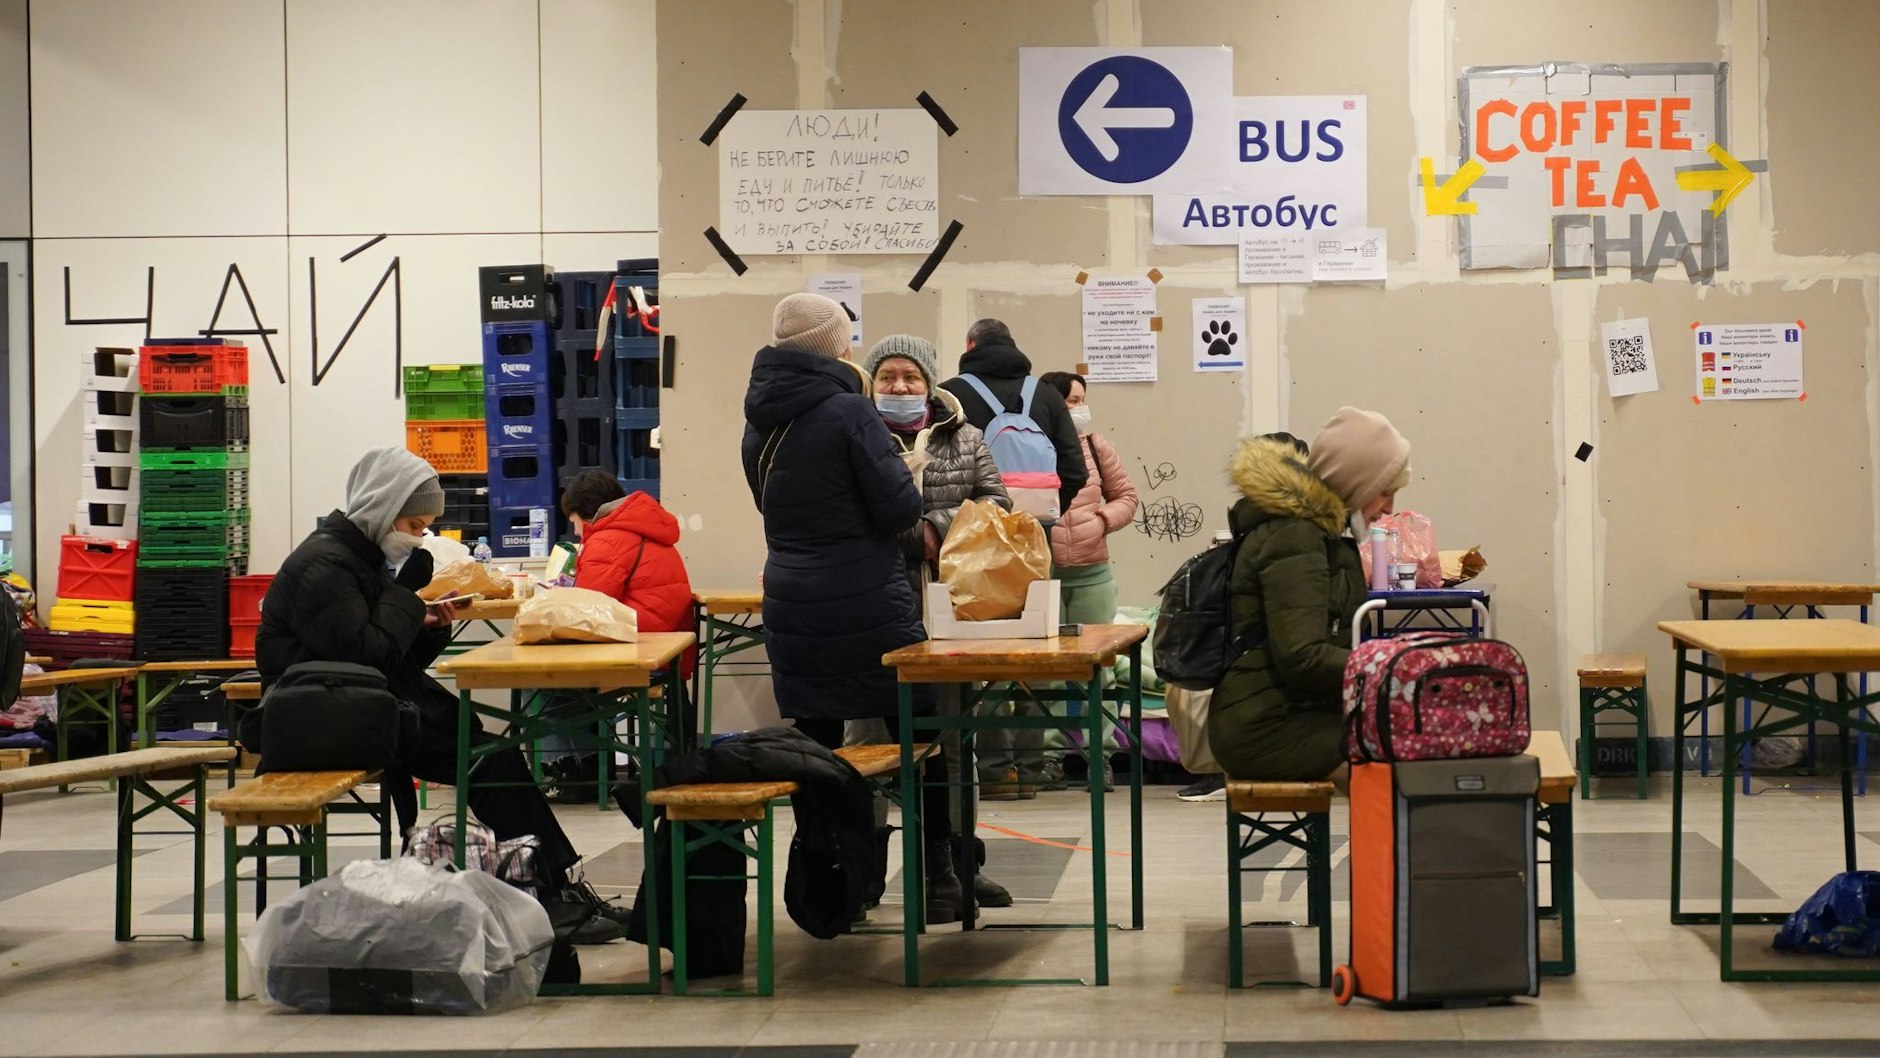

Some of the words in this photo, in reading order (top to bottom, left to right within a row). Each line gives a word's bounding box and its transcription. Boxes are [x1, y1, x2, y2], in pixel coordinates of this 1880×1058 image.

[786, 113, 879, 142] ЛЮДИ!
[1238, 119, 1344, 163] BUS
[1476, 98, 1692, 163] COFFEE
[730, 150, 749, 168] НЕ
[756, 150, 815, 168] БЕРИТЕ
[830, 149, 910, 167] ЛИШНЮЮ
[738, 179, 772, 197] ЕДУ
[783, 178, 793, 194] И
[879, 174, 926, 191] ТОЛЬКО
[1544, 156, 1660, 211] TEA
[796, 196, 876, 213] СМОЖЕТЕ
[1182, 194, 1338, 231] Автобус
[734, 222, 746, 238] И
[844, 221, 924, 237] УБИРАЙТЕ
[776, 240, 794, 252] ЗА
[1552, 210, 1716, 287] CHAI
[64, 233, 401, 400] ЧАЙ
